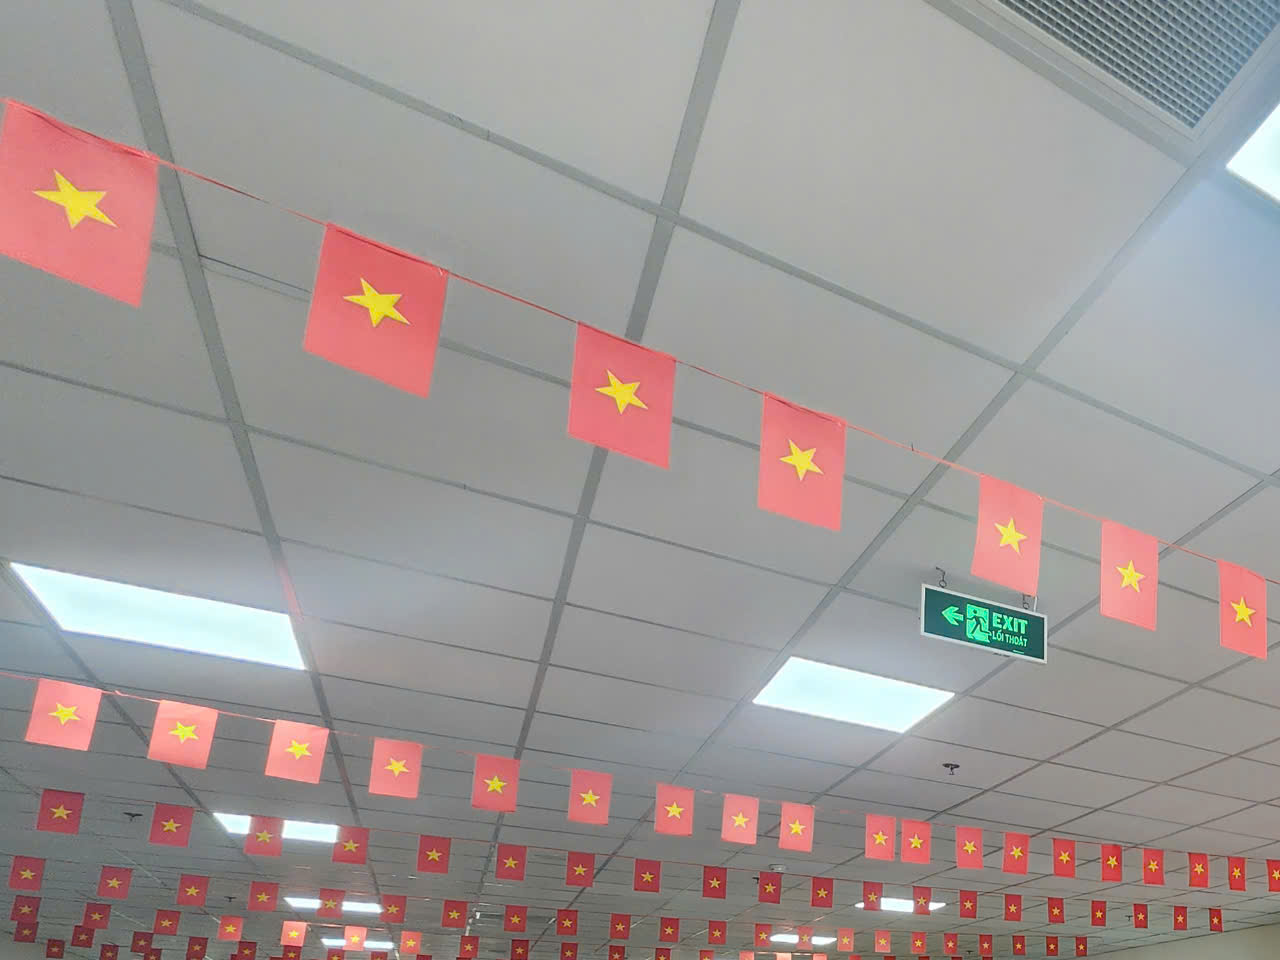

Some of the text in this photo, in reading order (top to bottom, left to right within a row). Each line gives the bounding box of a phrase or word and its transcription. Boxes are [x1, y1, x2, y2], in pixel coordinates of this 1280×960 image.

[992, 612, 1028, 635] EXIT
[992, 629, 1028, 647] LỐI THOÁT
